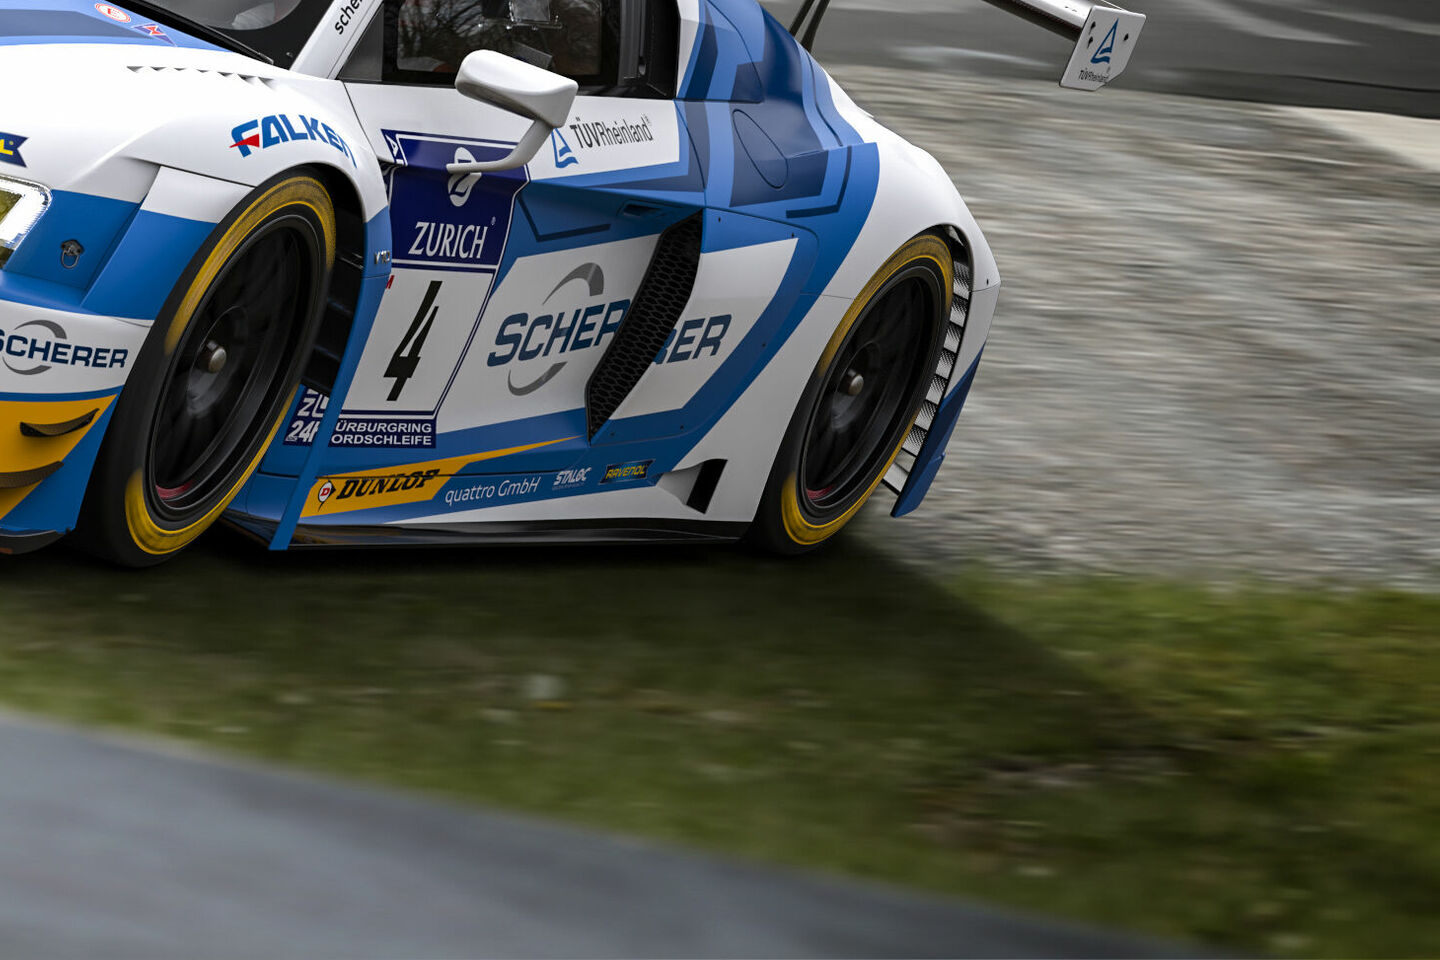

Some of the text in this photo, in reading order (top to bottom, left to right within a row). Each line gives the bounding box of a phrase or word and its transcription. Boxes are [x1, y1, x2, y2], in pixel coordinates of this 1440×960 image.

[229, 114, 357, 169] FALKEN
[408, 221, 488, 259] ZURICH
[383, 280, 443, 401] 4
[331, 434, 432, 445] ORDSCHLEIFE
[335, 420, 432, 433] ÜRBURGRING
[336, 469, 440, 500] DUNLOP
[605, 465, 646, 480] RAVENOL
[445, 484, 495, 506] quattro
[498, 477, 541, 497] GmbH
